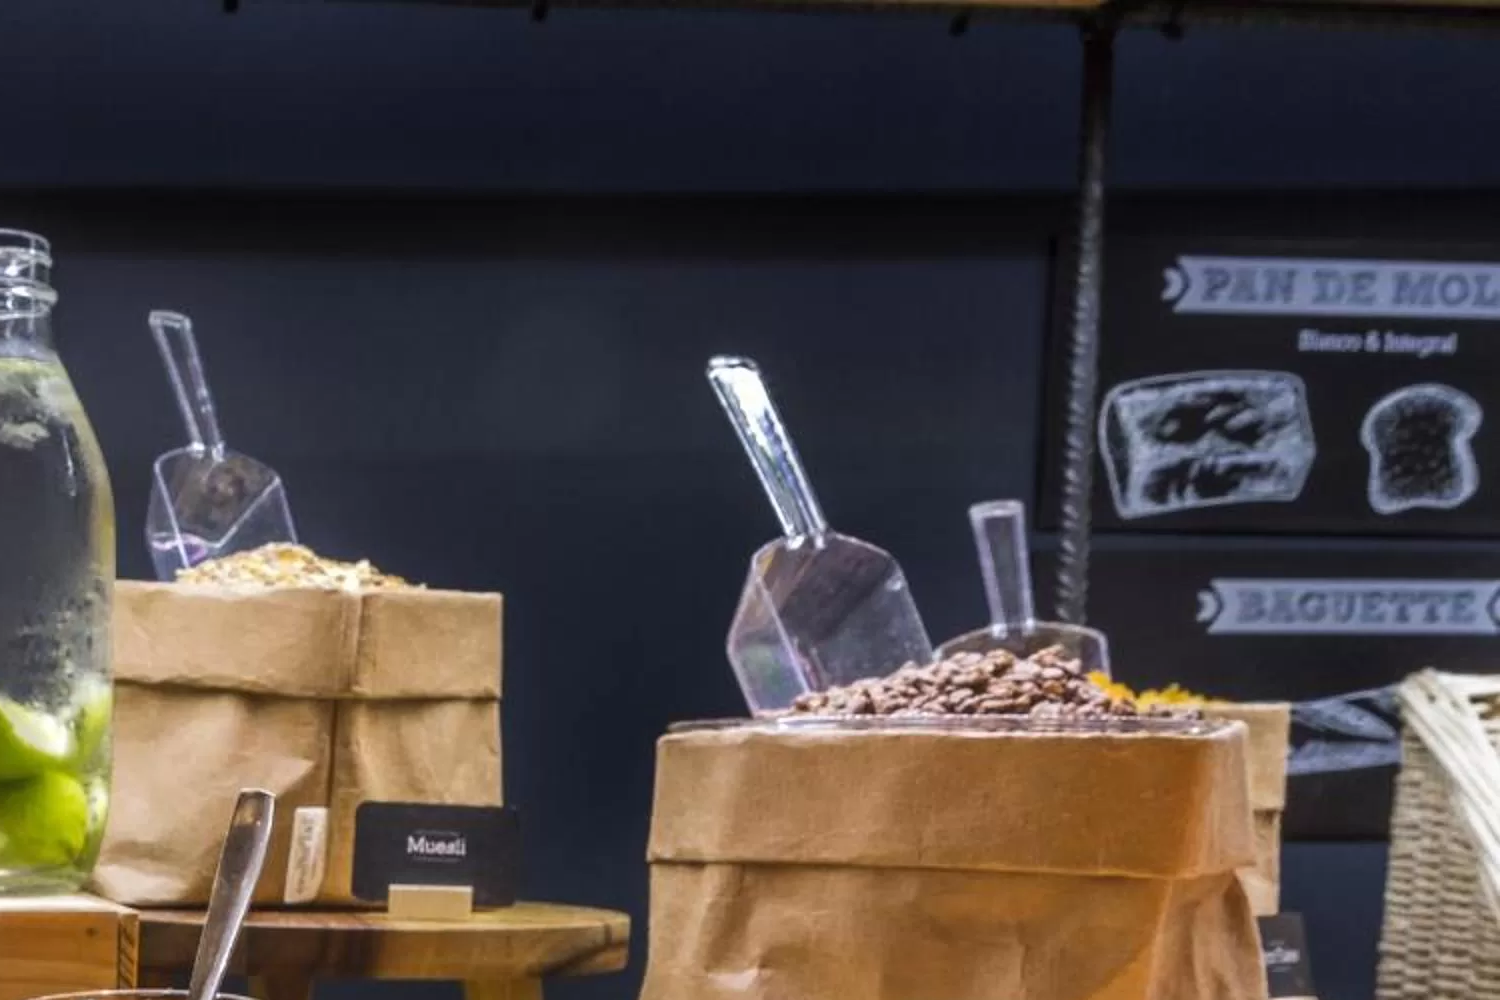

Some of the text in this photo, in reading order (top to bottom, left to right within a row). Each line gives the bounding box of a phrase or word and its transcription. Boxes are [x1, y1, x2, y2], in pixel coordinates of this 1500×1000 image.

[1202, 267, 1297, 304] PAN
[1312, 270, 1376, 306] DE
[1237, 589, 1477, 624] BAGUETTE
[406, 835, 467, 856] Muesli
